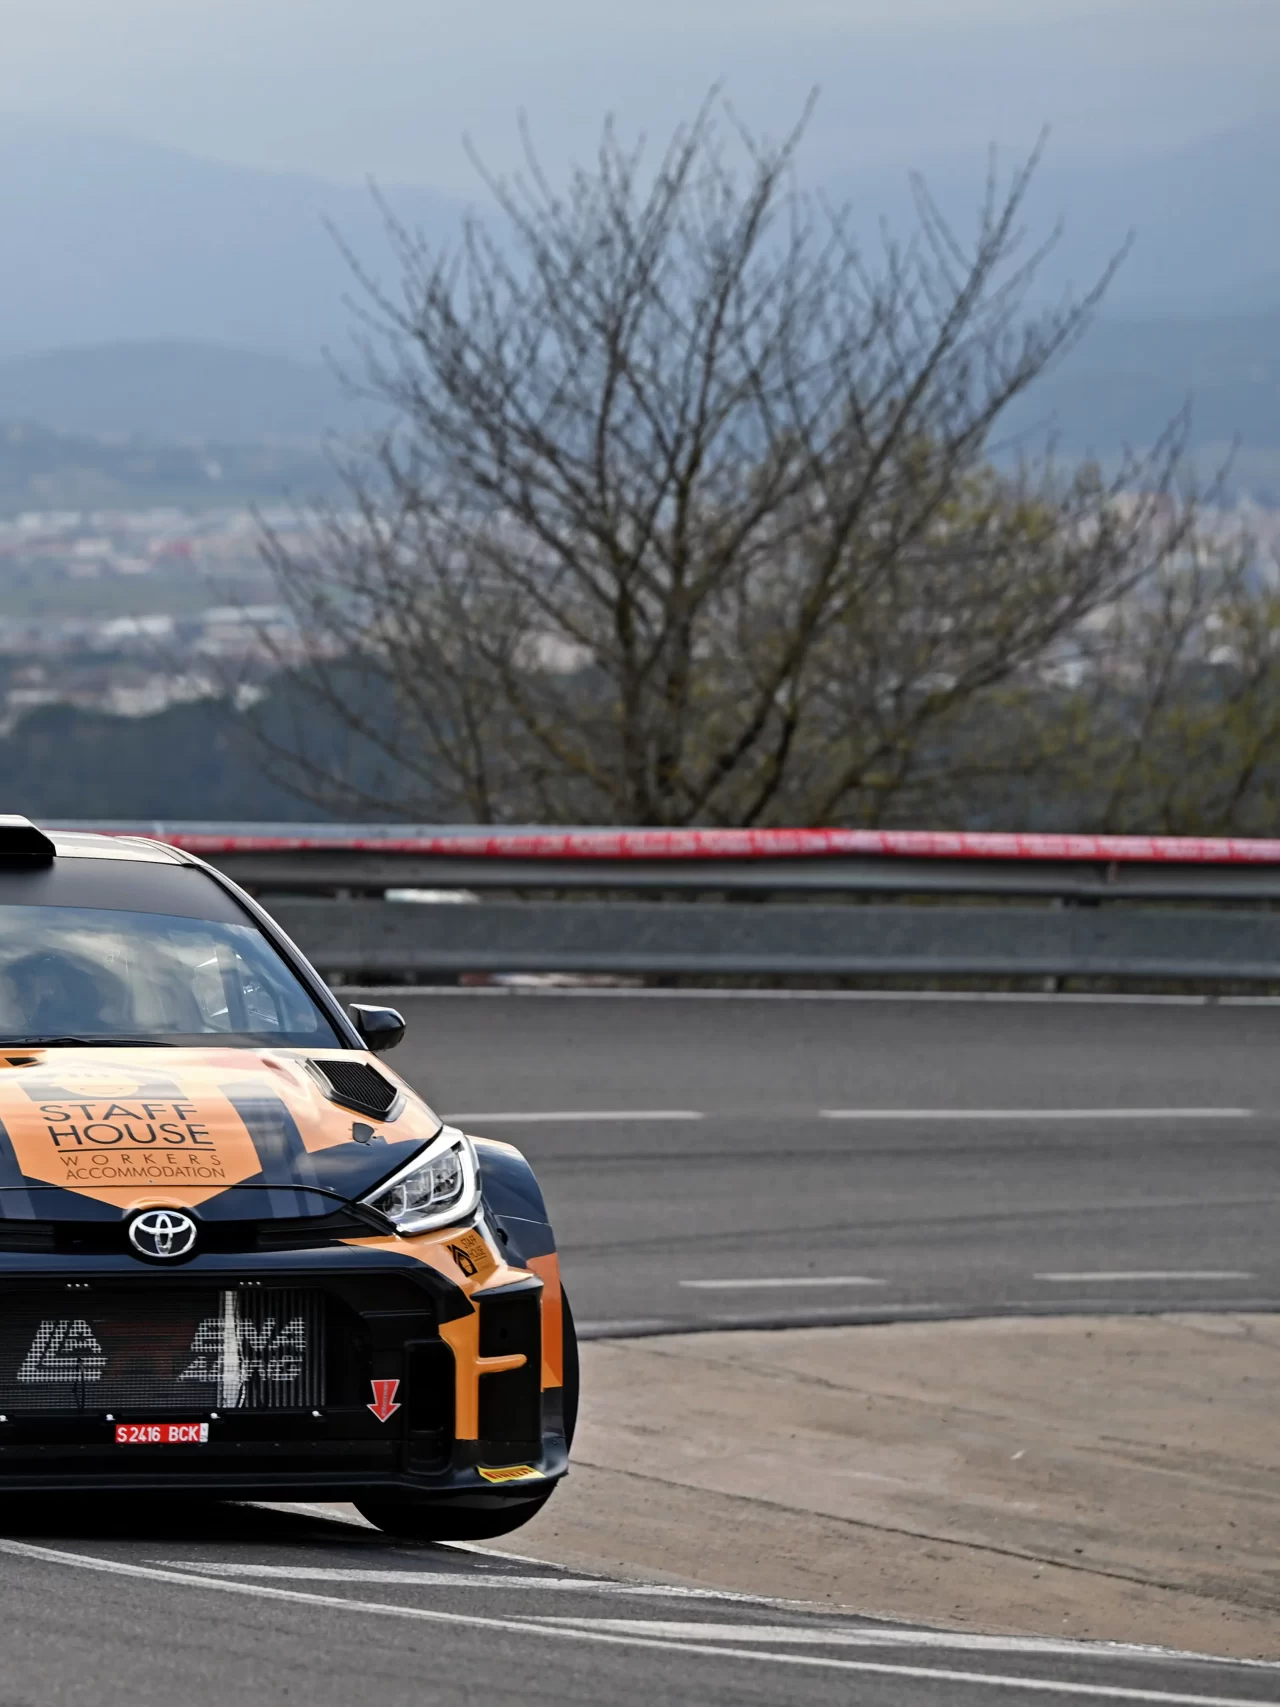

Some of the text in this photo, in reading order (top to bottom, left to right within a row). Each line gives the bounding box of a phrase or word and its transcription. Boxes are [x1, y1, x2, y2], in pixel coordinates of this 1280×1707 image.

[40, 1103, 198, 1122] STAFF
[47, 1123, 214, 1147] HOUSE
[60, 1153, 221, 1167] WORKERS
[66, 1165, 226, 1180] ACCOMMODATION
[128, 1426, 161, 1442] 2416
[168, 1425, 199, 1442] BCK
[484, 1467, 534, 1480] PIRELLI
